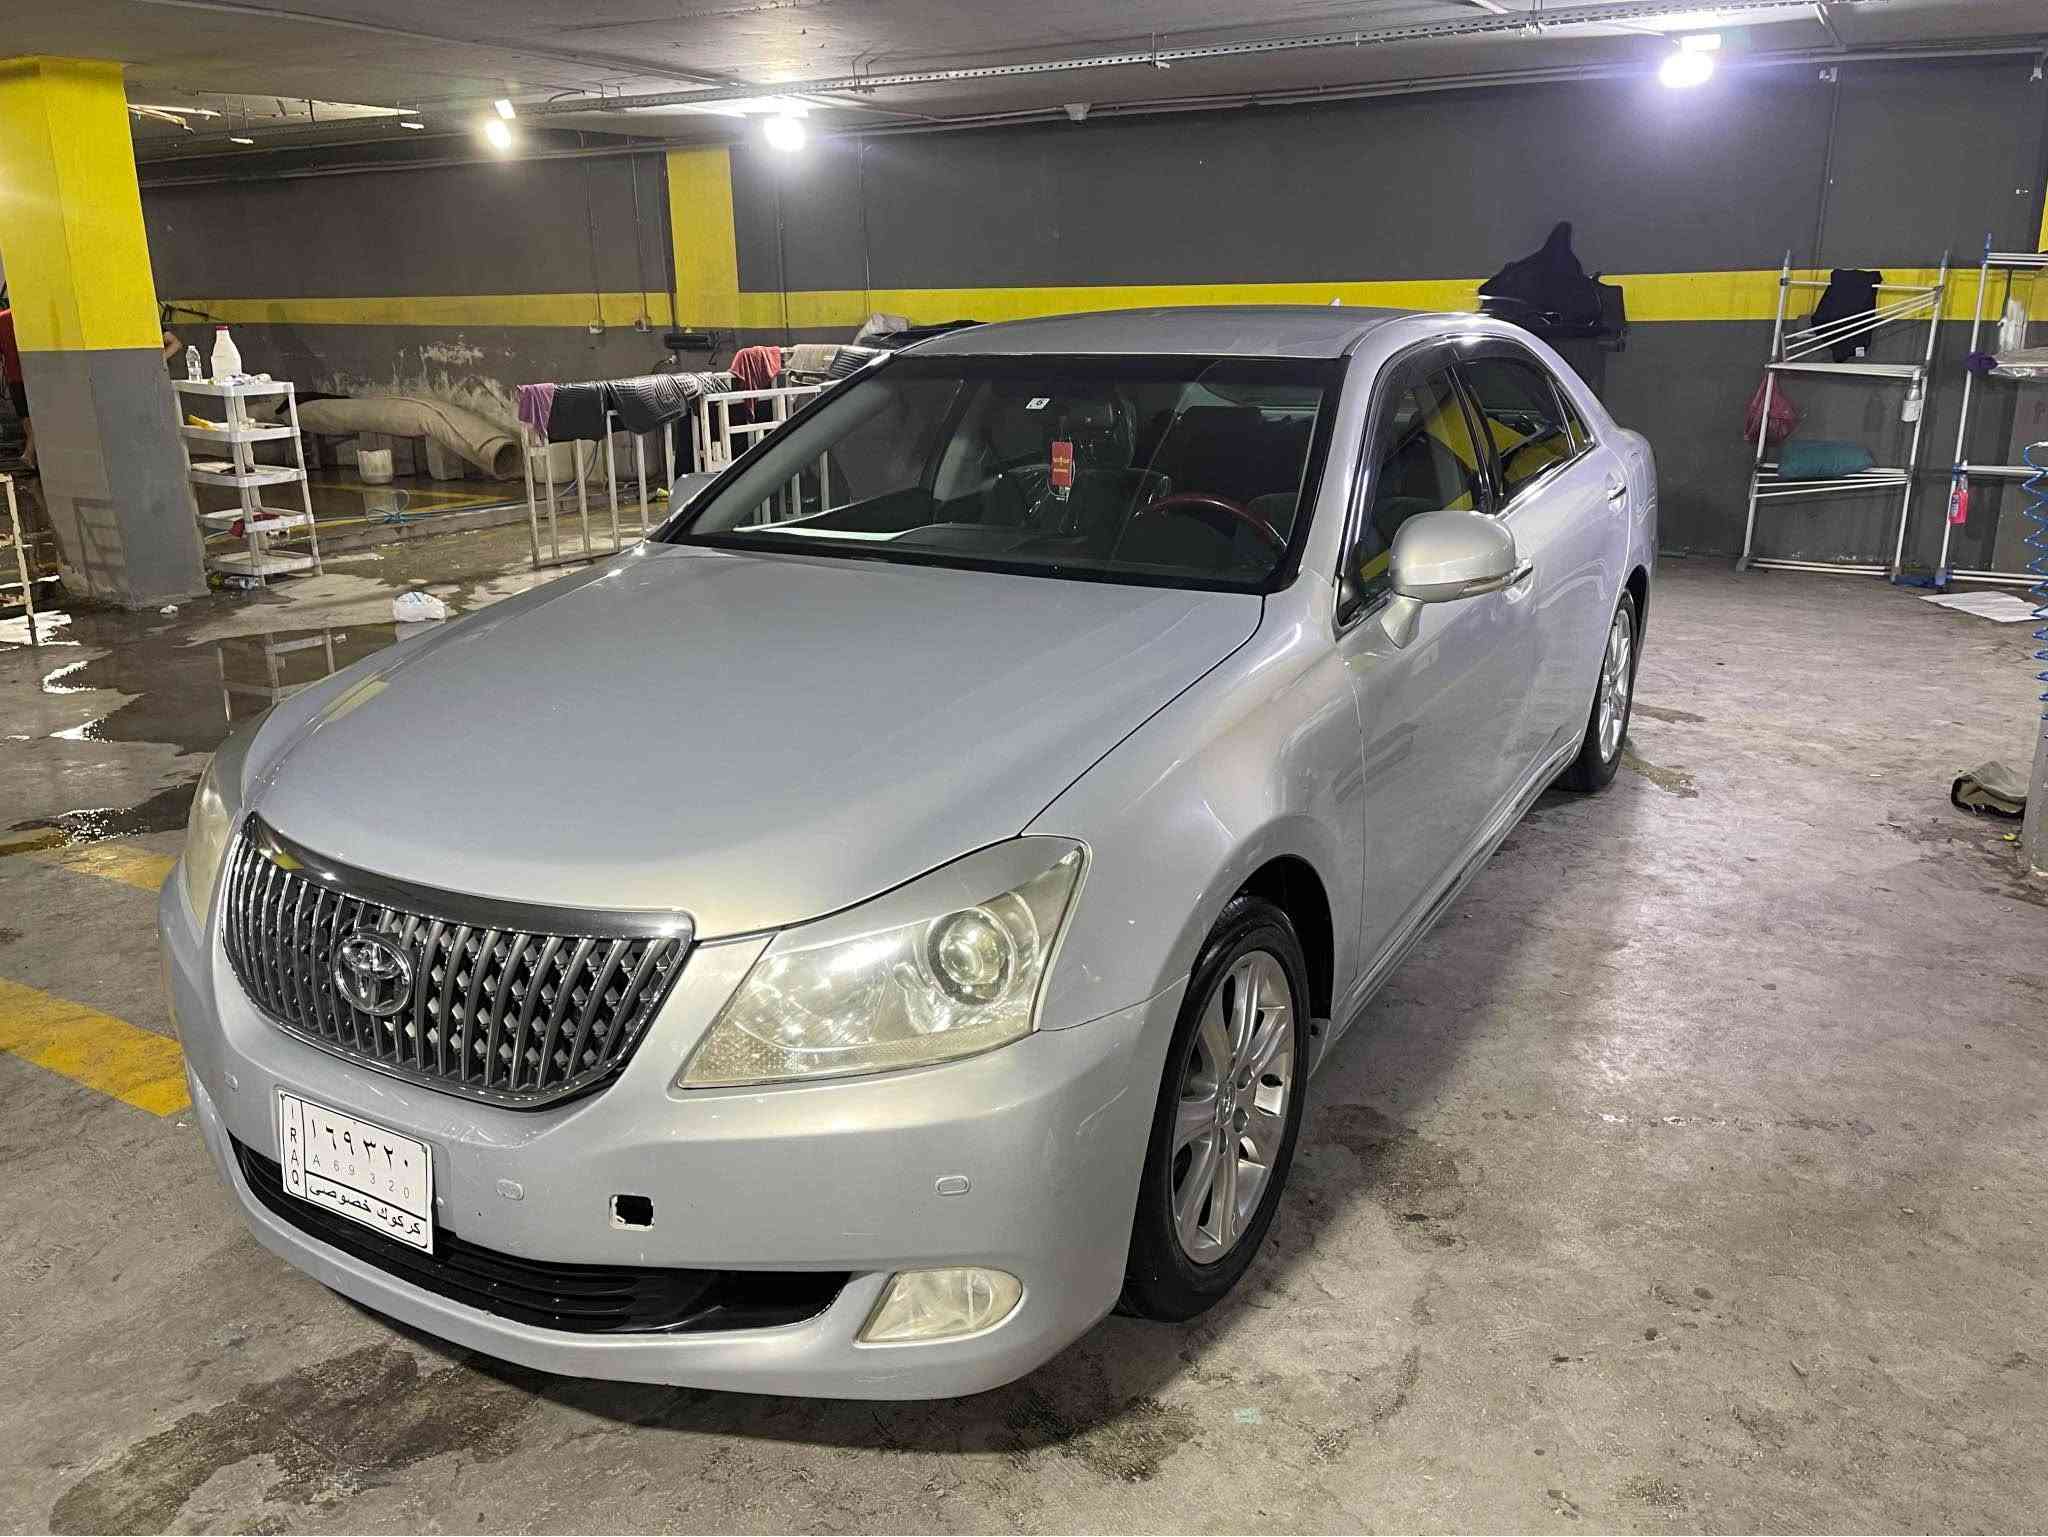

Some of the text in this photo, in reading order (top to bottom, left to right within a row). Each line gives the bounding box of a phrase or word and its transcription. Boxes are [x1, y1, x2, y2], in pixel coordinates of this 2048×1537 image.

[290, 1106, 300, 1187] IRAQ
[312, 1119, 409, 1169] ١٦٩٣٢٠
[377, 1207, 421, 1235] كركوك
